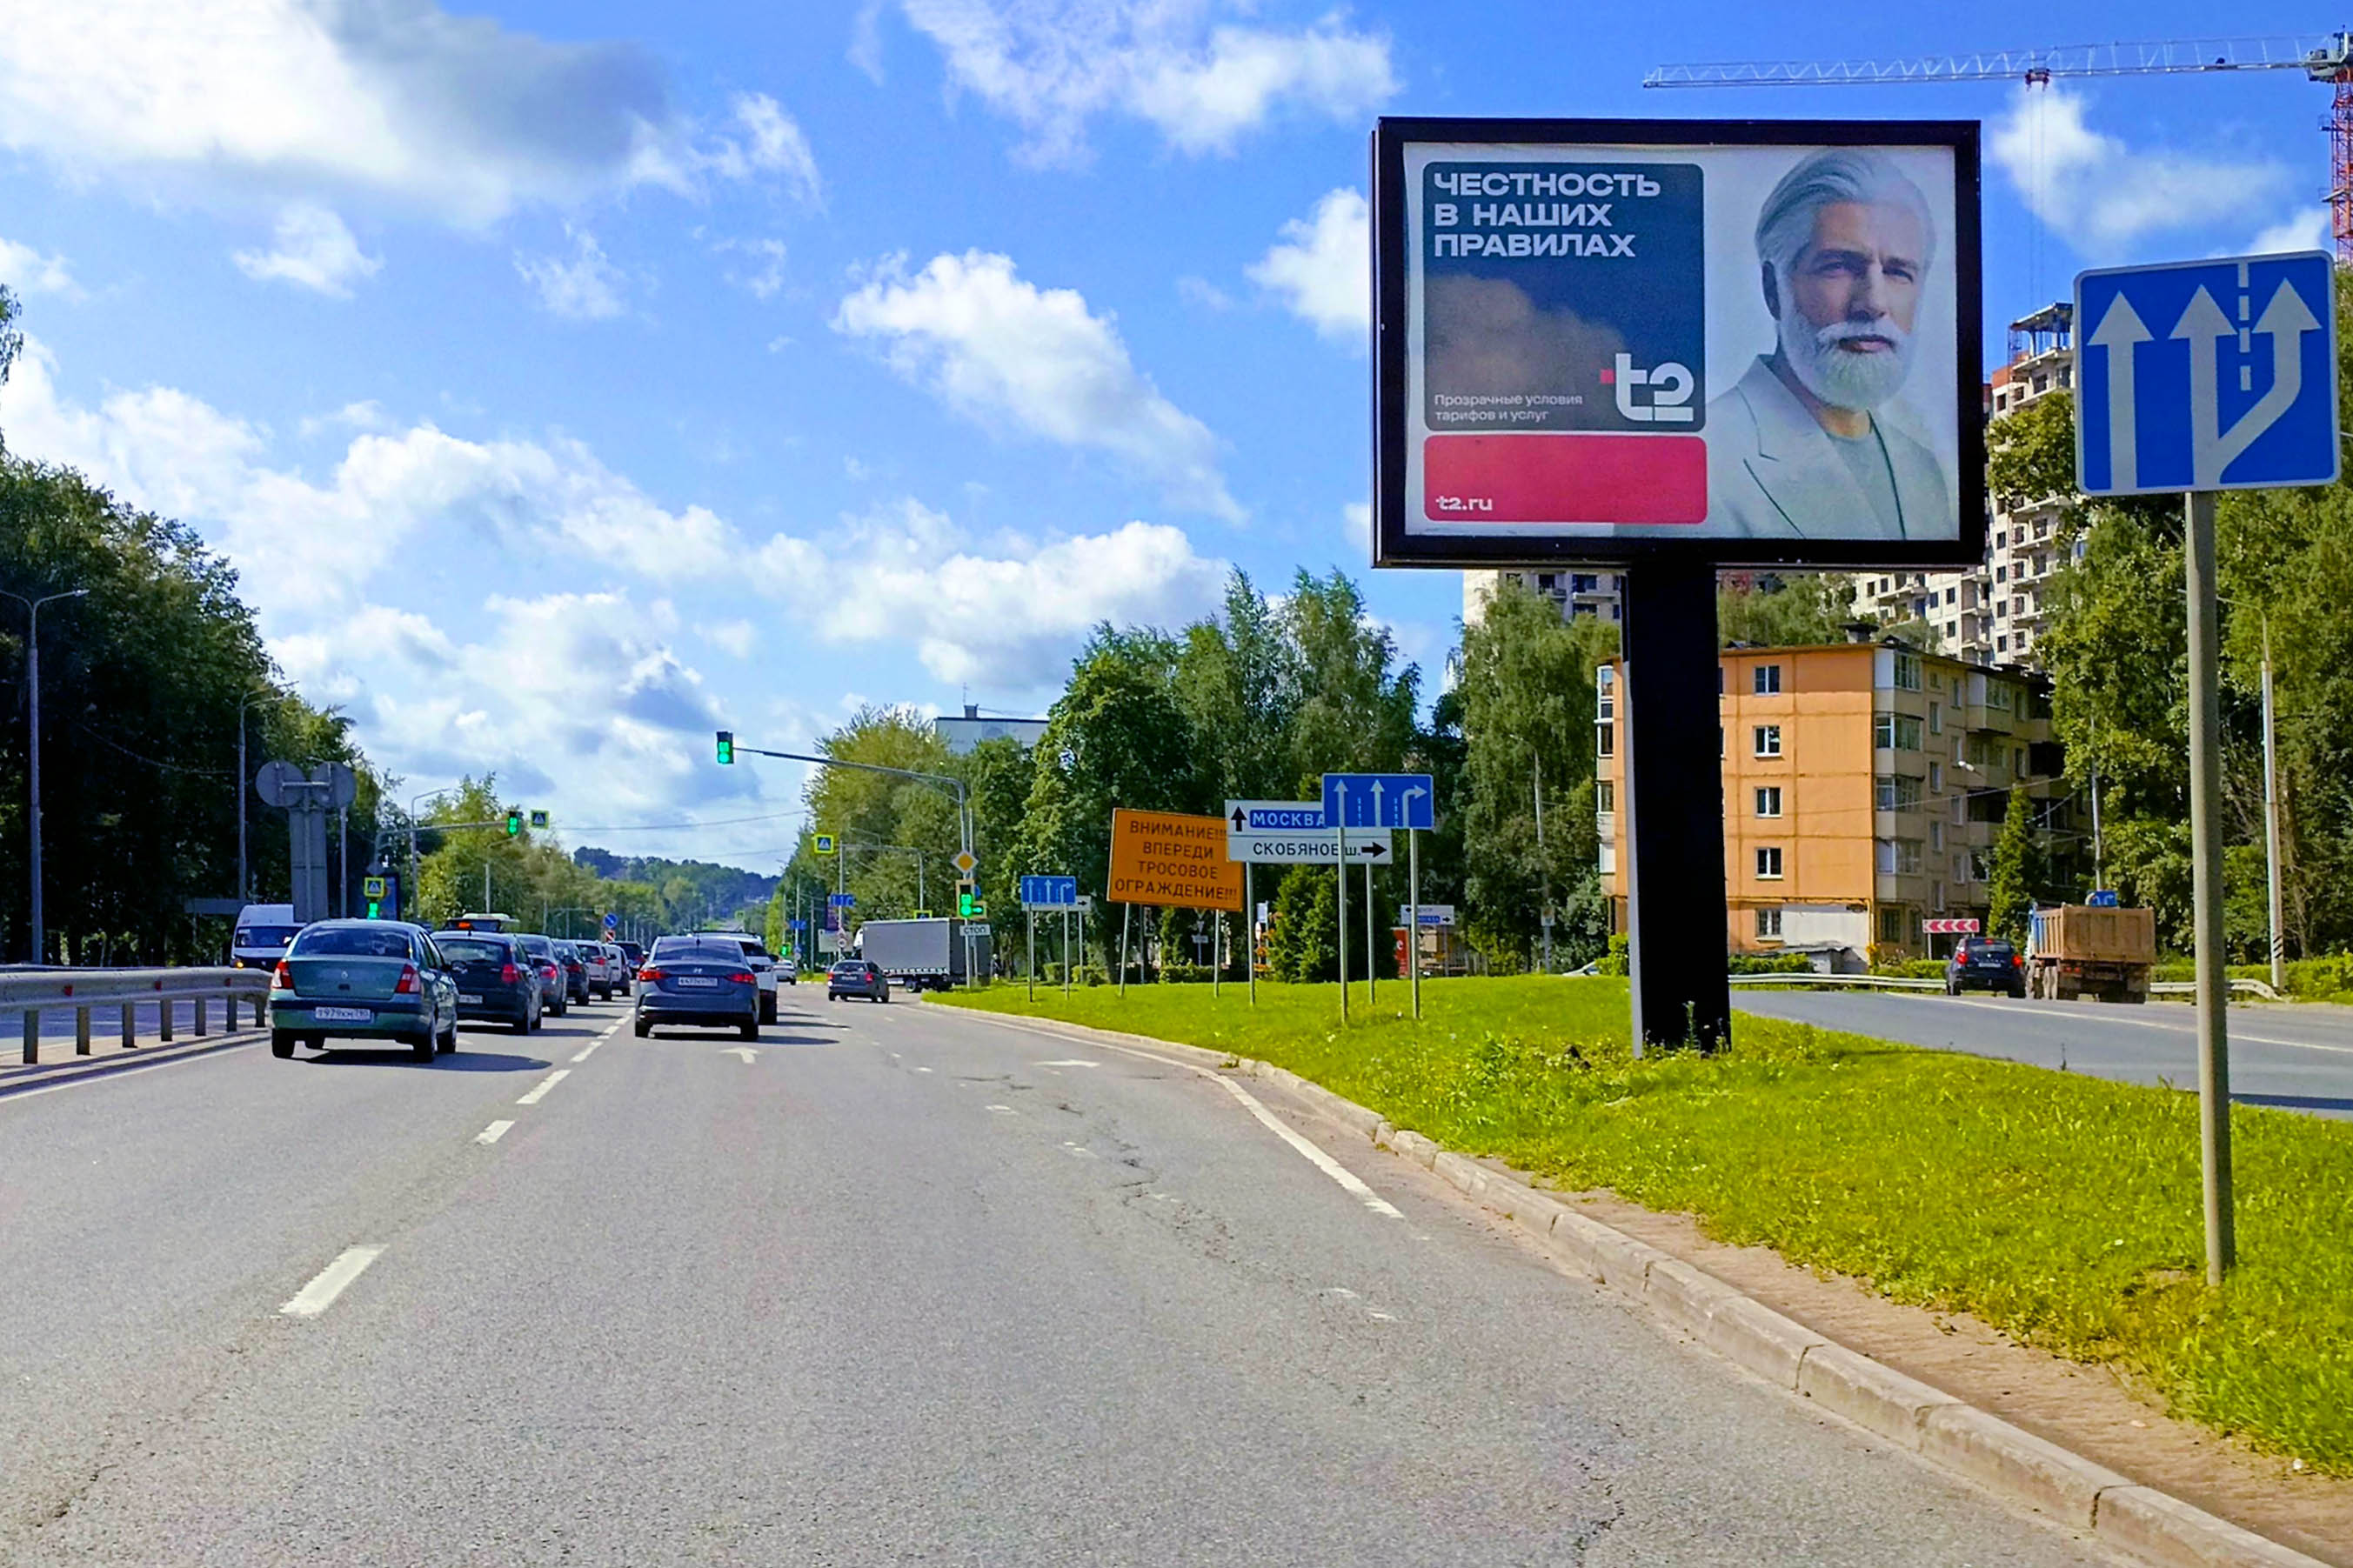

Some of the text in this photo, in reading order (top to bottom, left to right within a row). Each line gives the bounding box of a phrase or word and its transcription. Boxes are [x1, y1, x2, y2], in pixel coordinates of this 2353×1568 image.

[1434, 172, 1661, 197] ЧЕСТНОСТЬ
[1434, 204, 1613, 226] В НАШИХ
[1434, 234, 1636, 257] ПРАВИЛАХ
[1601, 353, 1695, 422] t2
[1434, 394, 1583, 407] Прозрачные условия
[1435, 410, 1496, 423] тарифов
[1510, 411, 1549, 423] услуг
[1436, 496, 1493, 511] t2.ru
[1252, 812, 1325, 826] МОСКВА
[1130, 820, 1227, 841] ВНИМАНИЕ!!!
[1143, 841, 1213, 860] ВПЕРЕДИ
[1137, 860, 1218, 880] ТРОСОВОЕ
[1114, 877, 1238, 901] ОГРАЖДЕНИЕ!!!
